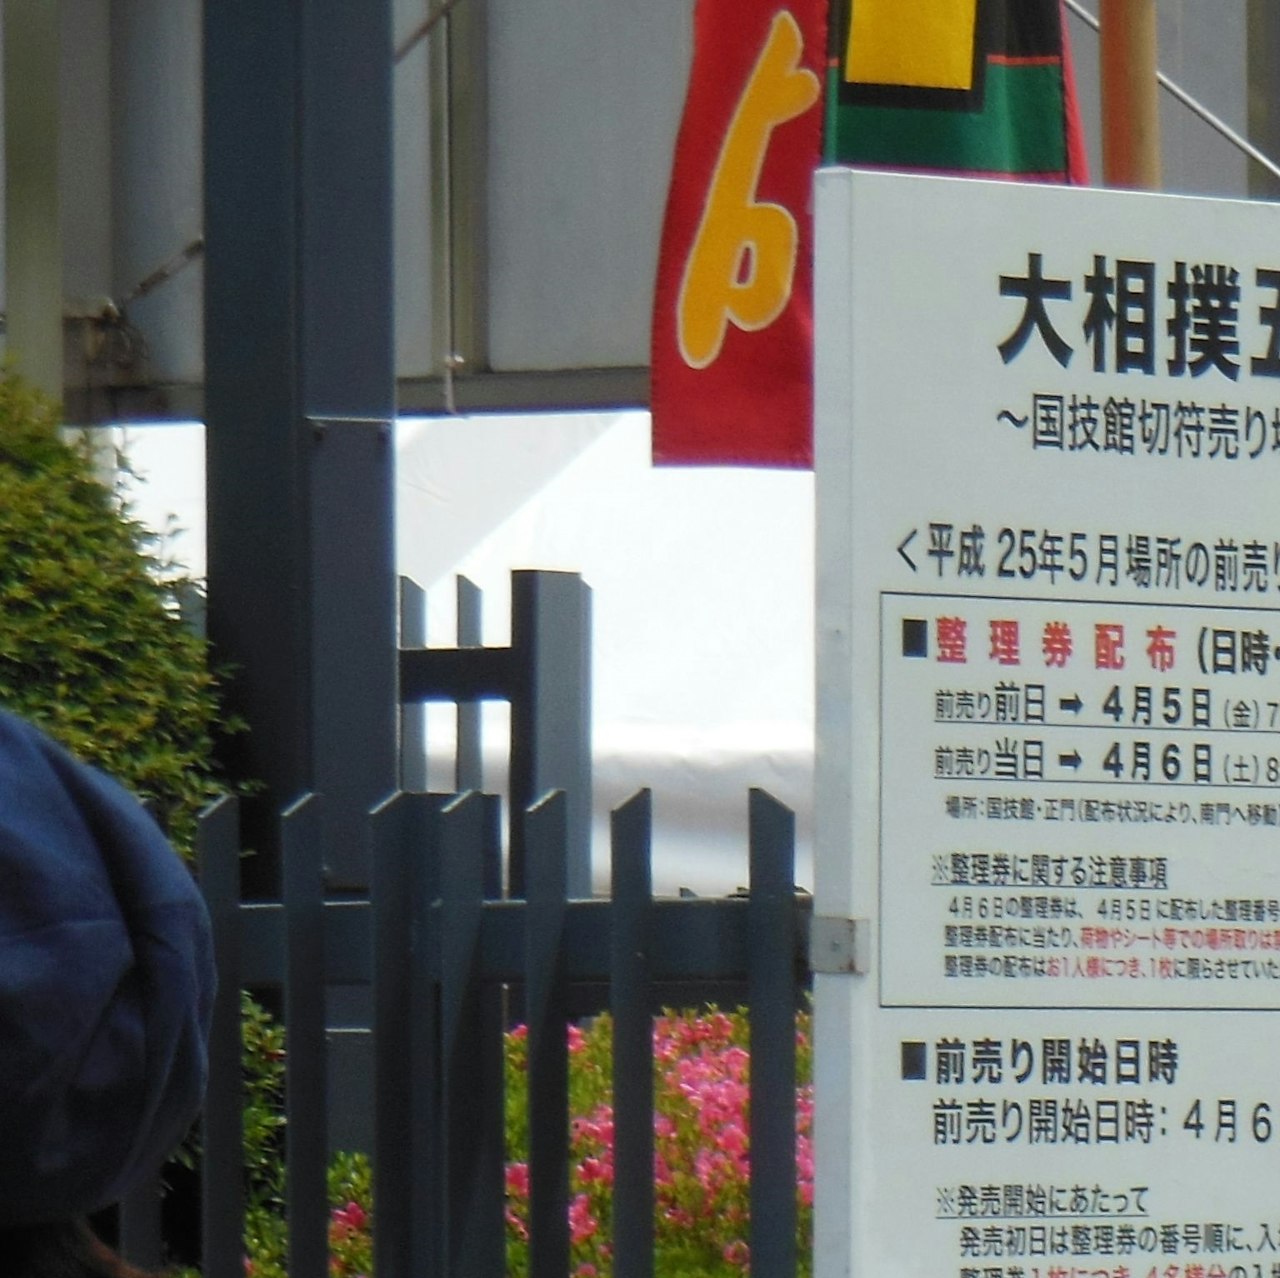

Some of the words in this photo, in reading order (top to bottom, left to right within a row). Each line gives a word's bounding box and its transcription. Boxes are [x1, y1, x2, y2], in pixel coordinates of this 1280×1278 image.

[935, 616, 1177, 672] 整理券配布
[935, 1038, 1179, 1085] 前売り開始日時
